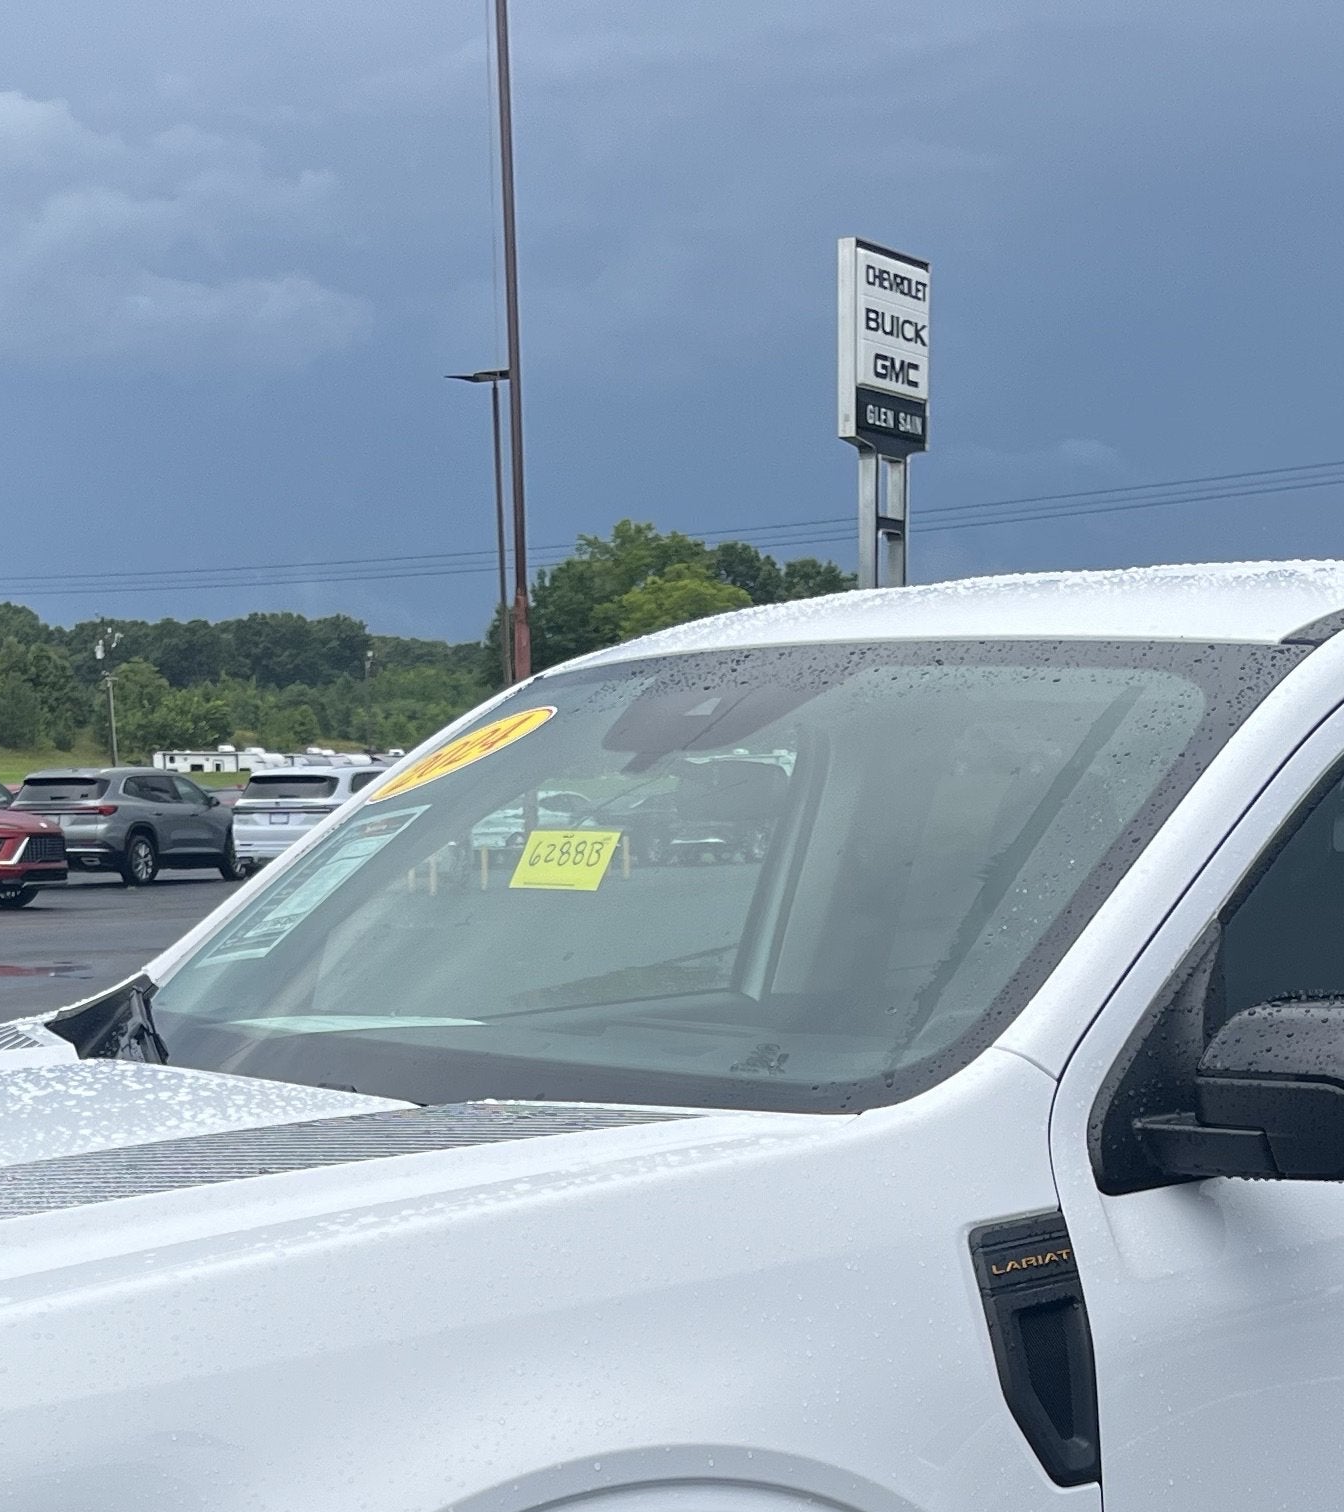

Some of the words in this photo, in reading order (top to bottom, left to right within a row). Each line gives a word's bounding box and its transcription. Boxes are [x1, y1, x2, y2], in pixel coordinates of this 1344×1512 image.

[866, 264, 928, 302] CHEVROLET
[865, 307, 928, 347] BUICK
[873, 353, 920, 388] GMC
[866, 404, 894, 429] GLEN
[898, 412, 923, 435] SAIN
[528, 840, 605, 868] 6288B
[991, 1248, 1071, 1275] LARIAT
